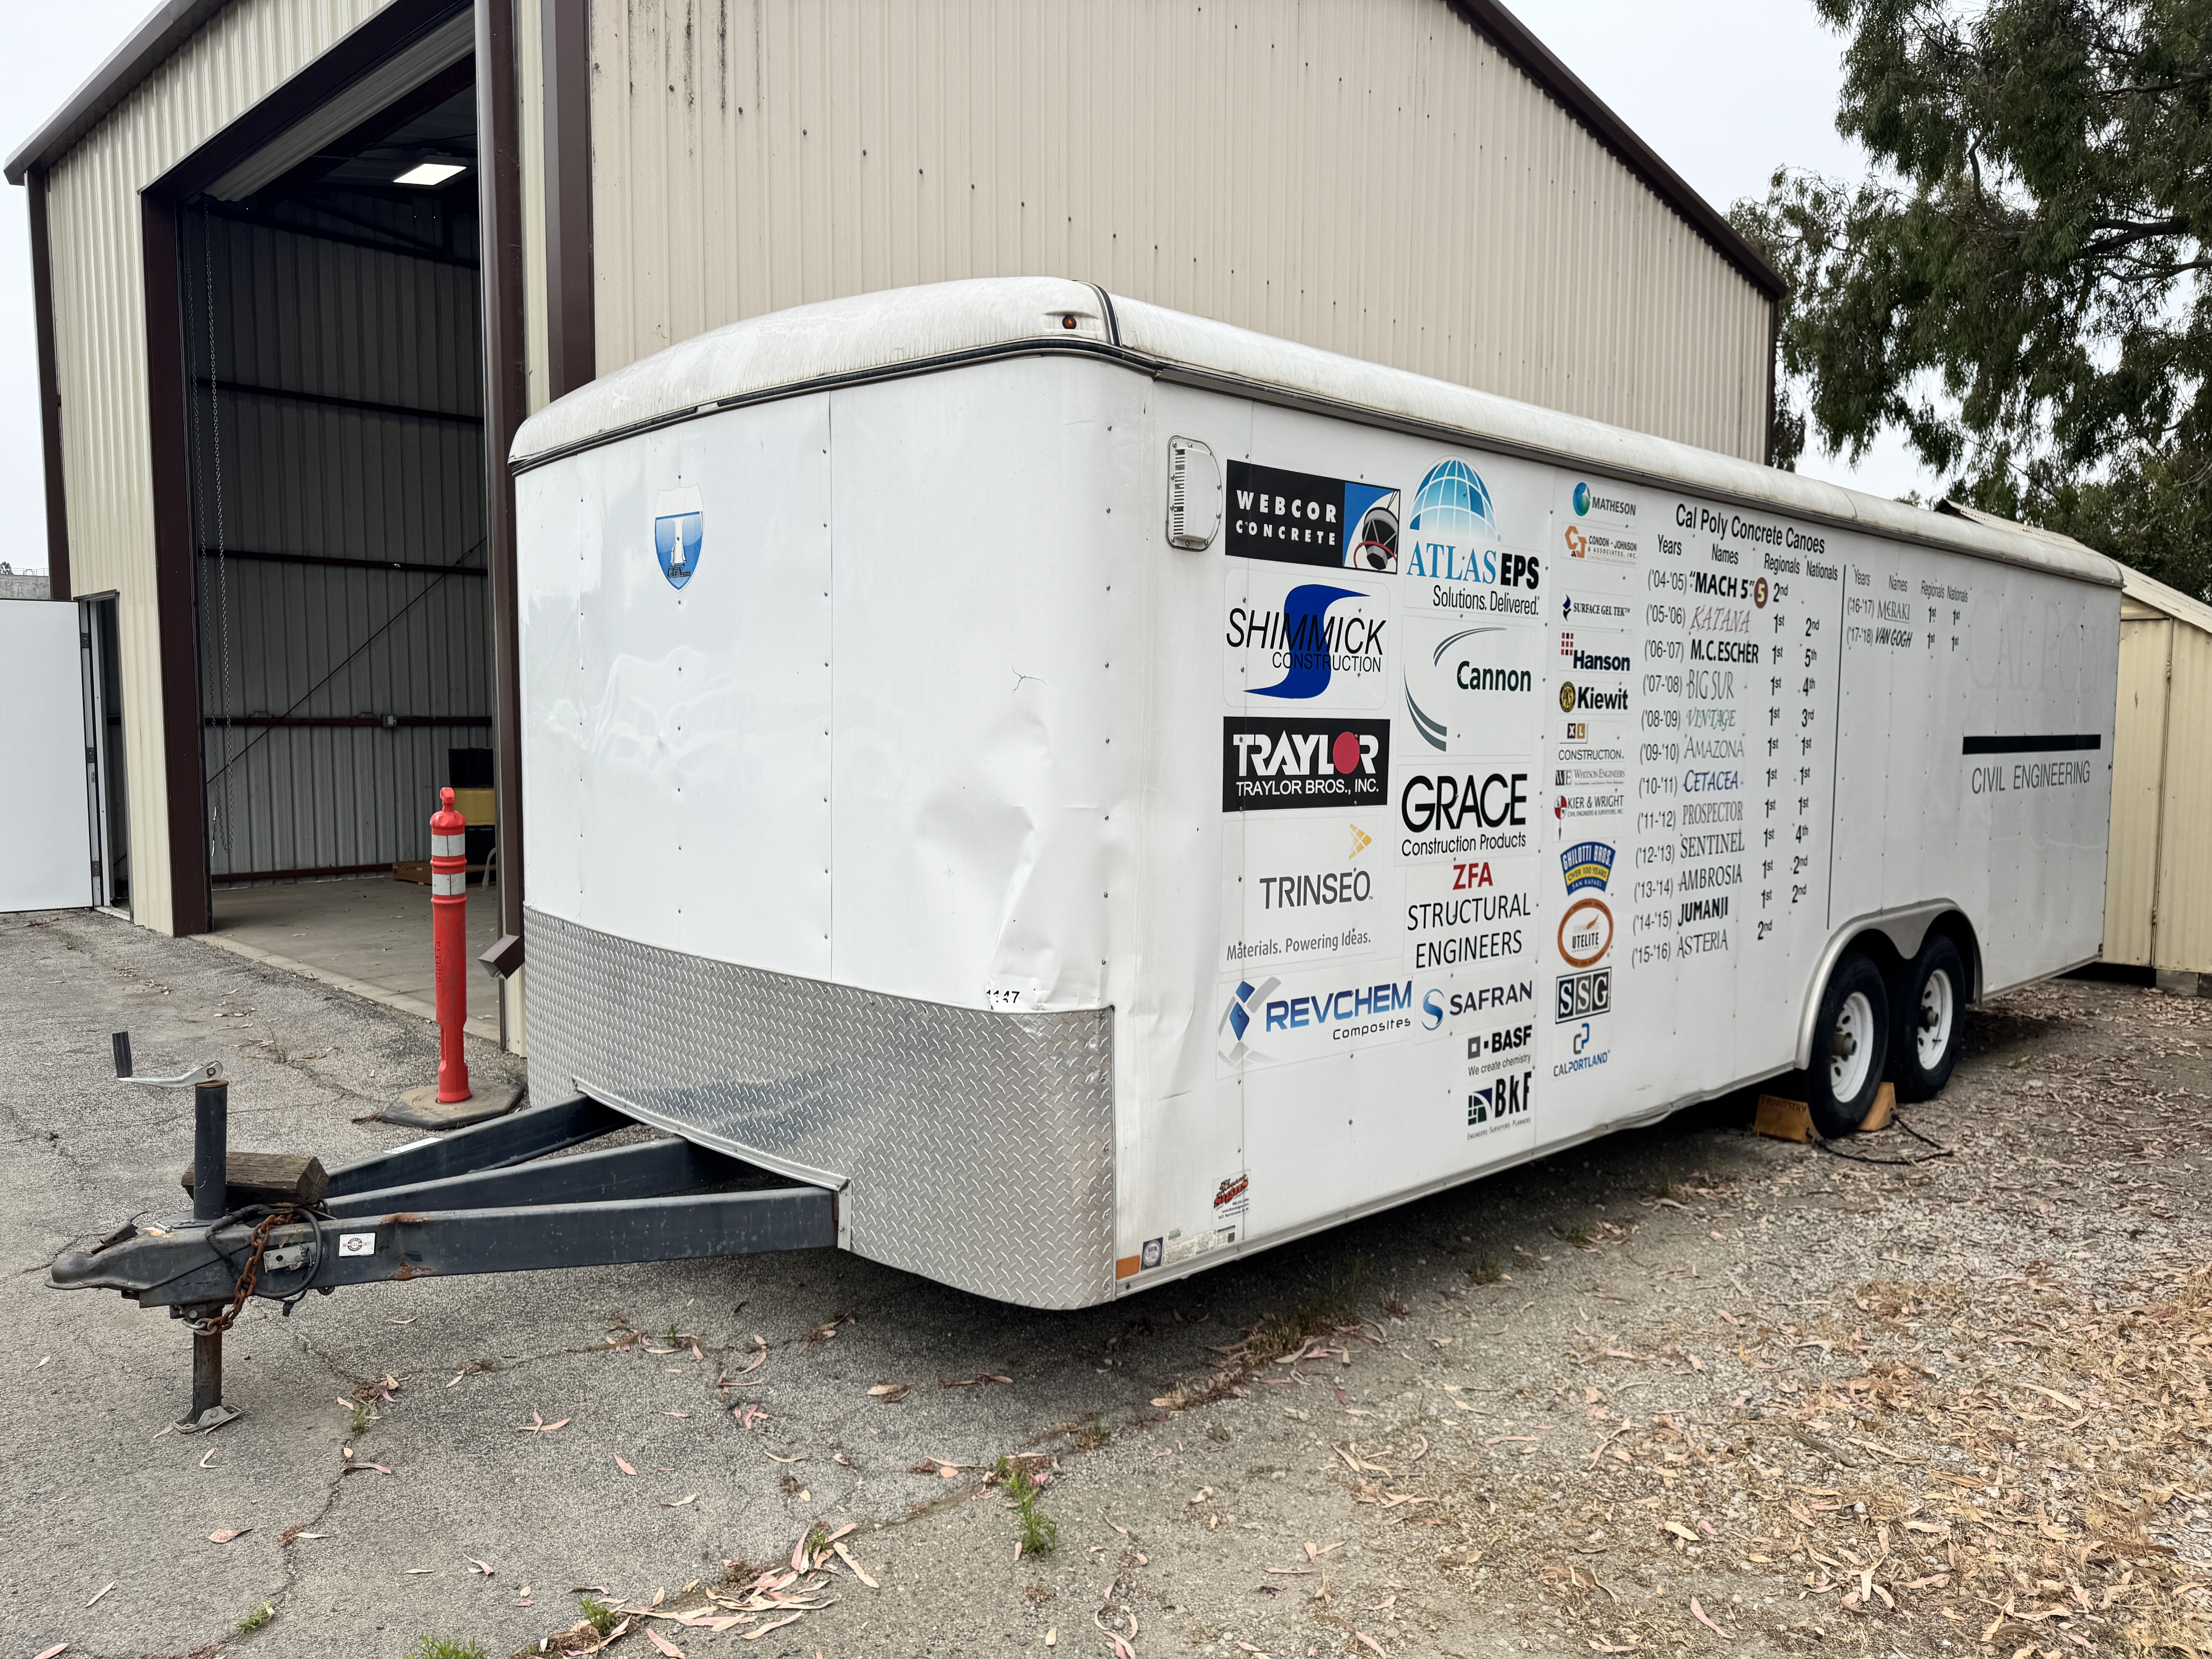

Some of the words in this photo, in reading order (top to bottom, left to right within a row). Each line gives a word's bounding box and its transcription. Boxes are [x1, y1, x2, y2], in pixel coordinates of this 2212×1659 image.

[1237, 490, 1336, 524] WEBCOR
[1592, 496, 1636, 516] MATHESON
[1236, 520, 1336, 546] CONCRETE
[1676, 503, 1697, 529] Cal
[1701, 509, 1728, 540] Poly
[1731, 515, 1782, 545] Concrete
[1786, 527, 1825, 554] Canoes
[1589, 536, 1609, 547] CONDON
[1614, 541, 1637, 551] JOHNSON
[1658, 534, 1682, 555] Years
[1711, 544, 1738, 565] Names
[1764, 553, 1800, 575] Regionals
[1806, 560, 1838, 580] Nationals
[1406, 541, 1496, 584] ATLAS
[1500, 553, 1539, 589] EPS
[1433, 585, 1487, 610] Solutions.
[1648, 569, 1687, 594] ('04-'05)
[1757, 583, 1765, 603] 5
[1774, 583, 1788, 603] 2nd
[1855, 568, 1870, 586] Years
[1889, 575, 1908, 592] Names
[1921, 580, 1945, 599] Regionals
[1947, 586, 1968, 603] Nationals
[1573, 603, 1600, 614] SURFACE
[1601, 605, 1612, 615] GEL
[1646, 604, 1686, 626] ('05-'06)
[1689, 605, 1750, 633] KATANA
[1774, 614, 1784, 633] 1st
[1805, 618, 1820, 637] 2nd
[1877, 600, 1910, 623] MERAKI
[1226, 608, 1386, 655] SHIMMICK
[1875, 627, 1891, 644] VAN
[1891, 629, 1913, 648] GOGH
[1272, 652, 1381, 672] CONSTRUCTION
[1573, 650, 1630, 671] Hanson
[1644, 639, 1684, 663] ('06-'07)
[1718, 641, 1759, 663] ESCHER
[1772, 646, 1783, 664] 1st
[1805, 650, 1817, 667] 5th
[1456, 661, 1531, 692] Cannon
[1643, 675, 1683, 697] ('07-'08)
[1688, 670, 1709, 699] BIG
[1711, 671, 1734, 700] SUR
[1771, 677, 1781, 696] 1st
[1802, 678, 1815, 697] 4th
[1578, 687, 1628, 709] Kiewit
[1568, 724, 1585, 738] XL
[1641, 710, 1681, 731] ('08-'09)
[1686, 707, 1736, 731] VINTAGE
[1769, 707, 1780, 726] 1st
[1802, 709, 1814, 727] 3rd
[1233, 730, 1379, 776] TRAYLOR
[1640, 744, 1680, 765] ('09-'10)
[1684, 737, 1744, 759] AMAZONA
[1768, 737, 1779, 756] 1st
[1802, 737, 1812, 756] 1st
[1236, 781, 1302, 796] TRAYLOR
[1306, 780, 1351, 795] BROS.,
[1355, 778, 1379, 793] INC.
[1638, 777, 1678, 799] ('10-'11)
[1683, 770, 1738, 793] CETACEA
[1766, 768, 1777, 787] 1st
[1800, 767, 1810, 785] 1st
[1972, 766, 2006, 794] CIVIL
[2013, 761, 2090, 790] ENGINEERING
[1401, 773, 1528, 833] GRACE
[1568, 797, 1584, 809] KIER
[1587, 796, 1592, 808] &
[1595, 795, 1625, 807] WRIGHT
[1637, 811, 1676, 834] ('11-'12)
[1683, 801, 1743, 826] PROSPECTOR
[1765, 799, 1776, 818] 1st
[1799, 797, 1809, 815] 1st
[1401, 835, 1476, 856] Construction
[1480, 831, 1526, 850] Products
[1563, 845, 1592, 870] GHILOTTI
[1594, 845, 1611, 867] BROS.
[1636, 844, 1675, 869] ('12-'13)
[1680, 832, 1744, 859] SENTINEL
[1764, 828, 1774, 847] 1st
[1796, 825, 1808, 843] 4th
[1452, 862, 1493, 890] ZFA
[1568, 869, 1581, 881] OVER
[1592, 867, 1607, 878] YEARS
[1634, 878, 1673, 903] ('13-'14)
[1680, 864, 1743, 891] AMBROSIA
[1762, 860, 1773, 879] 1st
[1793, 856, 1808, 874] 2nd
[1407, 893, 1530, 931] STRUCTURAL
[1633, 910, 1672, 936] ('14-'15)
[1678, 897, 1728, 927] JUMANJI
[1761, 890, 1772, 908] 1st
[1792, 884, 1807, 903] 2nd
[1227, 939, 1281, 961] Materials.
[1286, 934, 1338, 952] Powering
[1341, 931, 1370, 946] Ideas.
[1416, 930, 1522, 969] ENGINEERS
[1572, 933, 1599, 948] UTELITE
[1631, 942, 1671, 966] ('15-'16)
[1677, 929, 1728, 958] ASTERIA
[1758, 921, 1772, 940] 2nd
[1266, 981, 1412, 1032] REVCHEM
[1449, 981, 1532, 1016] SAFRAN
[1560, 974, 1607, 1015] SSG
[1333, 1017, 1411, 1040] Composites
[1492, 1025, 1532, 1053] BASF
[1468, 1066, 1479, 1076] We
[1481, 1062, 1500, 1073] create
[1503, 1054, 1531, 1067] chemistry
[1553, 1052, 1607, 1077] CALPORTLAND
